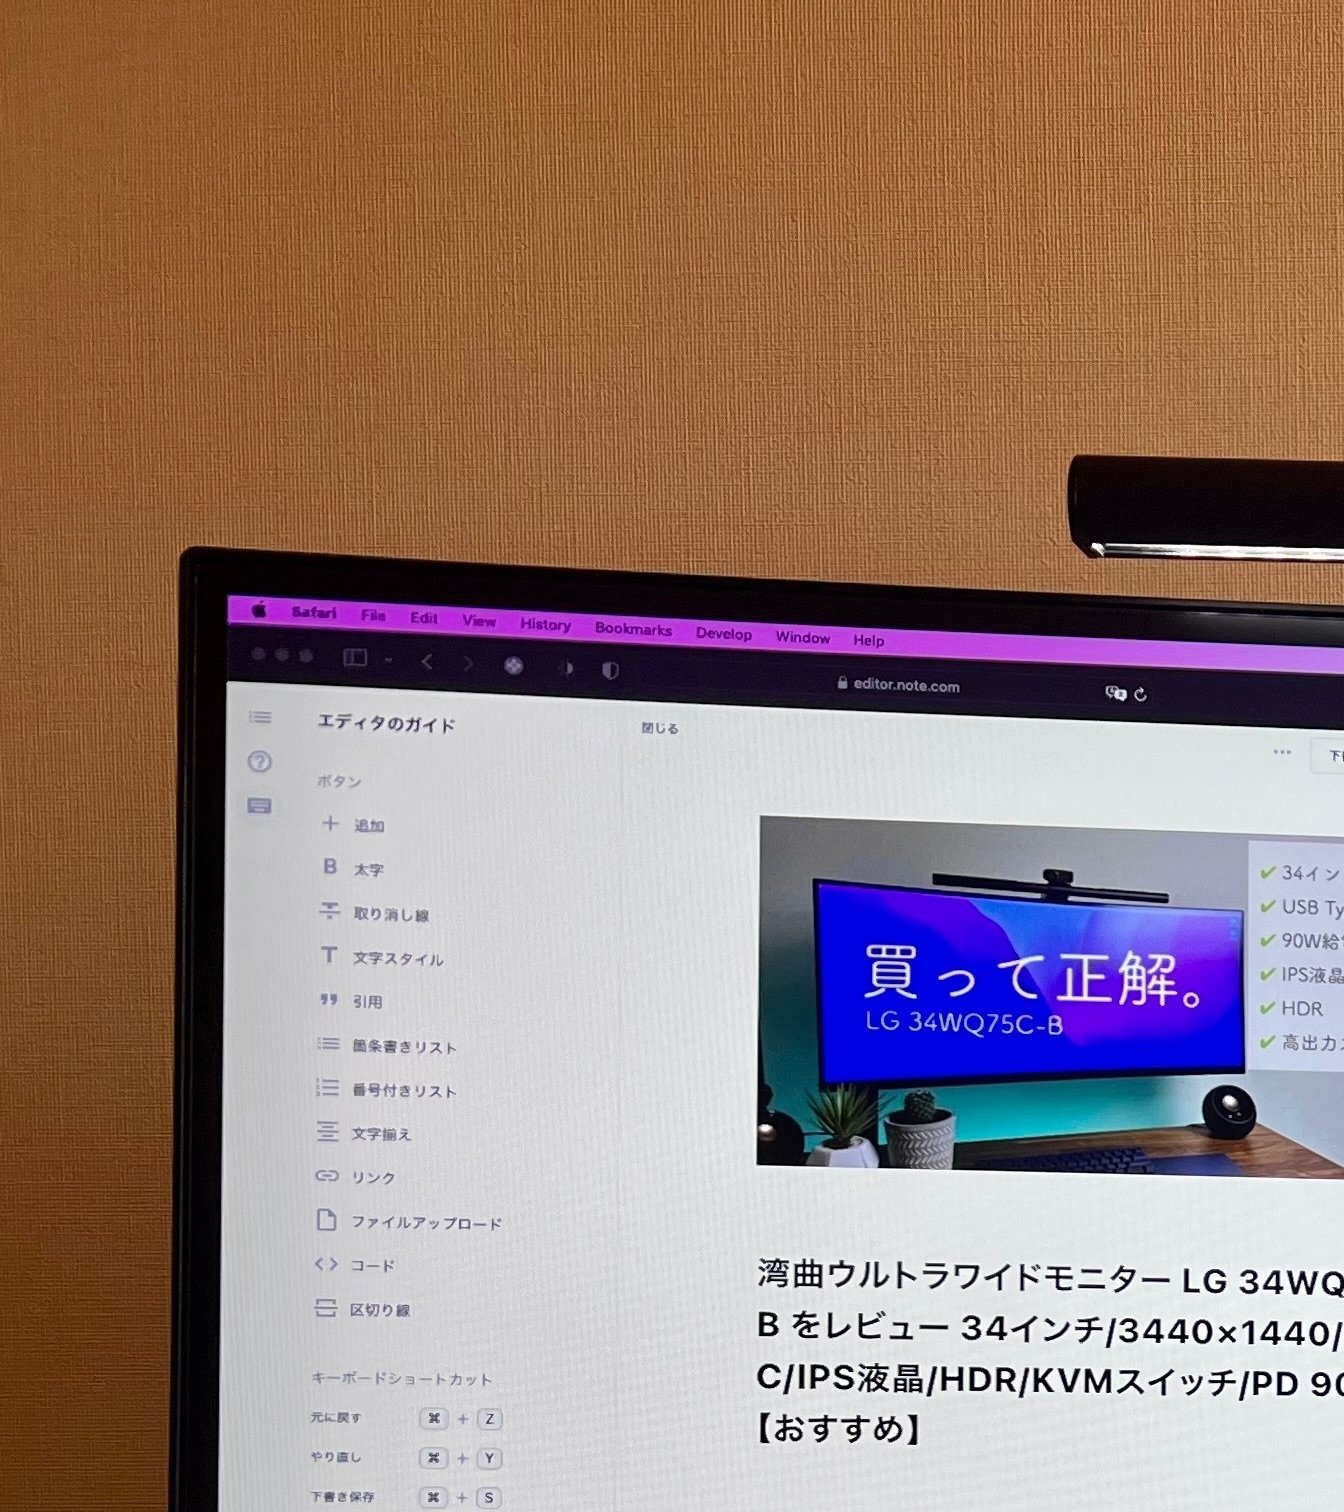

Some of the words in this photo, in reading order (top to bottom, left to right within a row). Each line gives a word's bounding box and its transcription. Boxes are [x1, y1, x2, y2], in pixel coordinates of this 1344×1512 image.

[292, 607, 336, 619] Safari
[361, 609, 386, 621] File
[411, 612, 438, 624] Edit
[462, 614, 496, 628] View
[521, 618, 571, 633] History
[596, 622, 672, 636] Bookmarks
[696, 627, 752, 642] Develop
[776, 631, 830, 644] Window
[854, 635, 884, 648] Help
[854, 678, 960, 692] editor.note.com
[319, 714, 455, 733] エディタのガイド
[642, 722, 678, 734] 閉じる
[1283, 899, 1318, 915] USB
[354, 951, 443, 966] 文字スタイル
[864, 944, 1200, 1009] 買って正解。
[1283, 967, 1344, 984] IPS液晶
[1283, 1001, 1323, 1016] HDR
[866, 1010, 900, 1031] LG
[910, 1011, 1063, 1037] 34WQ75C-B
[354, 1172, 394, 1184] リンク
[353, 1216, 501, 1231] ファイルアップロード
[759, 1258, 1170, 1293] 湾曲ウルトラワイドモニター
[1184, 1268, 1226, 1293] LG
[759, 1312, 779, 1336] B
[792, 1311, 948, 1340] をレビュー
[312, 1371, 491, 1386] キーボードショートカット
[757, 1363, 1298, 1401] C/IPS液晶/HDR/KVMスイッチ/PD
[760, 1413, 917, 1445] 【おすすめ】
